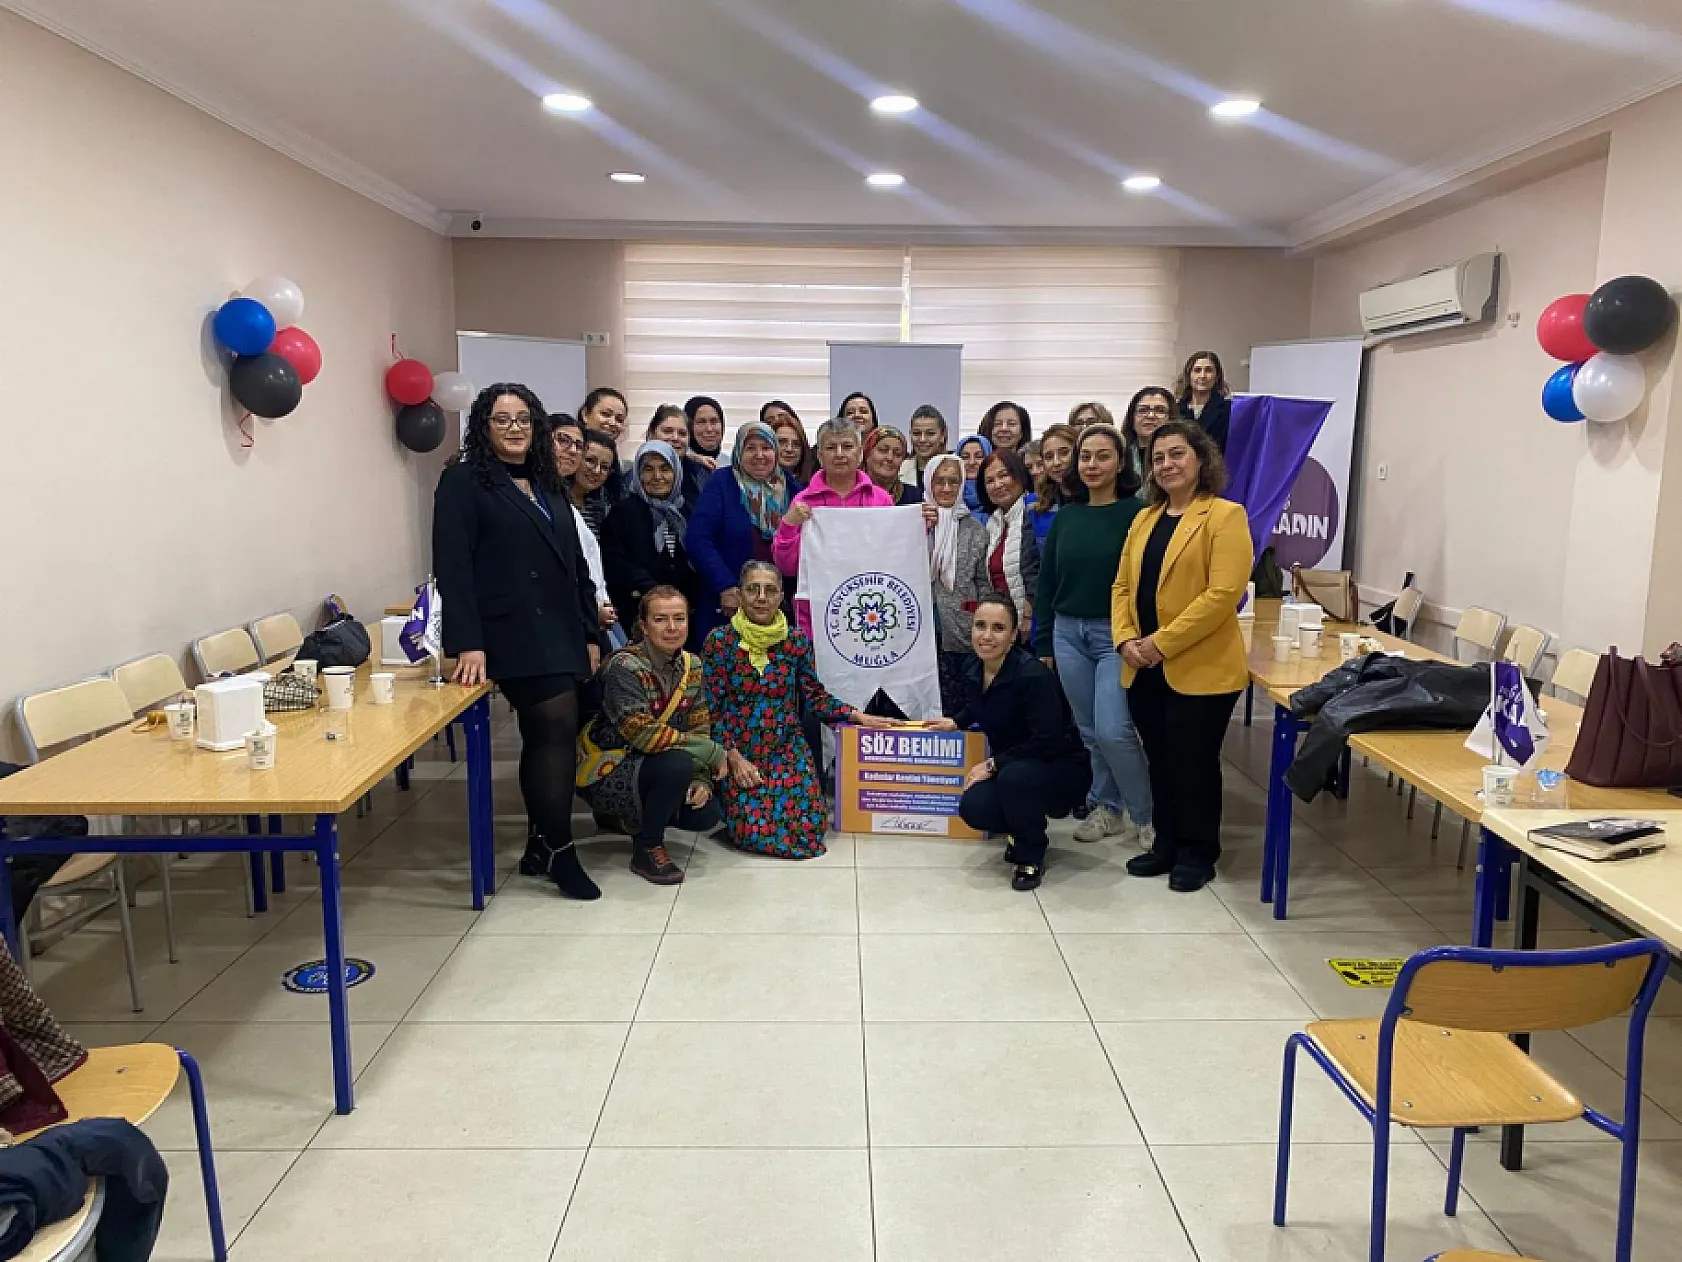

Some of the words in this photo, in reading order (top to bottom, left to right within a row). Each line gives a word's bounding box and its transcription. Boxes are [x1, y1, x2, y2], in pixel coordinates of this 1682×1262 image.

[1272, 512, 1329, 540] ADIN
[860, 732, 895, 755] SÖZ
[898, 735, 962, 759] BENİM!
